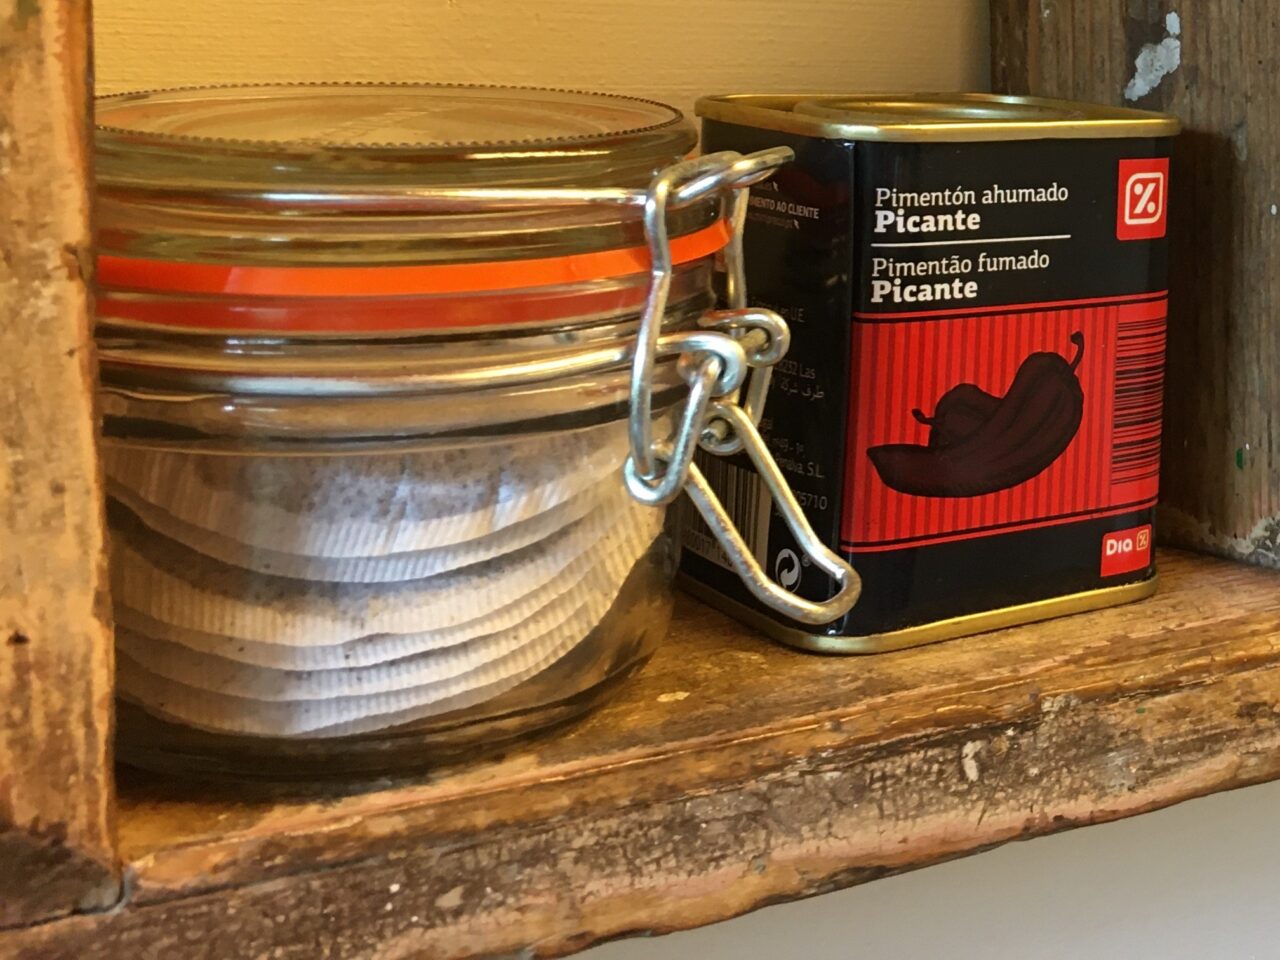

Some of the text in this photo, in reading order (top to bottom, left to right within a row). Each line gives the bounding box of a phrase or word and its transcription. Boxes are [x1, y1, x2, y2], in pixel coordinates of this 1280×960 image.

[875, 182, 1069, 208] Pimentón ahumado
[788, 202, 820, 219] CLIENTE
[874, 209, 981, 233] Picante
[871, 250, 1050, 278] Pimentão fumado
[870, 278, 978, 303] Picante
[799, 492, 828, 511] 5710
